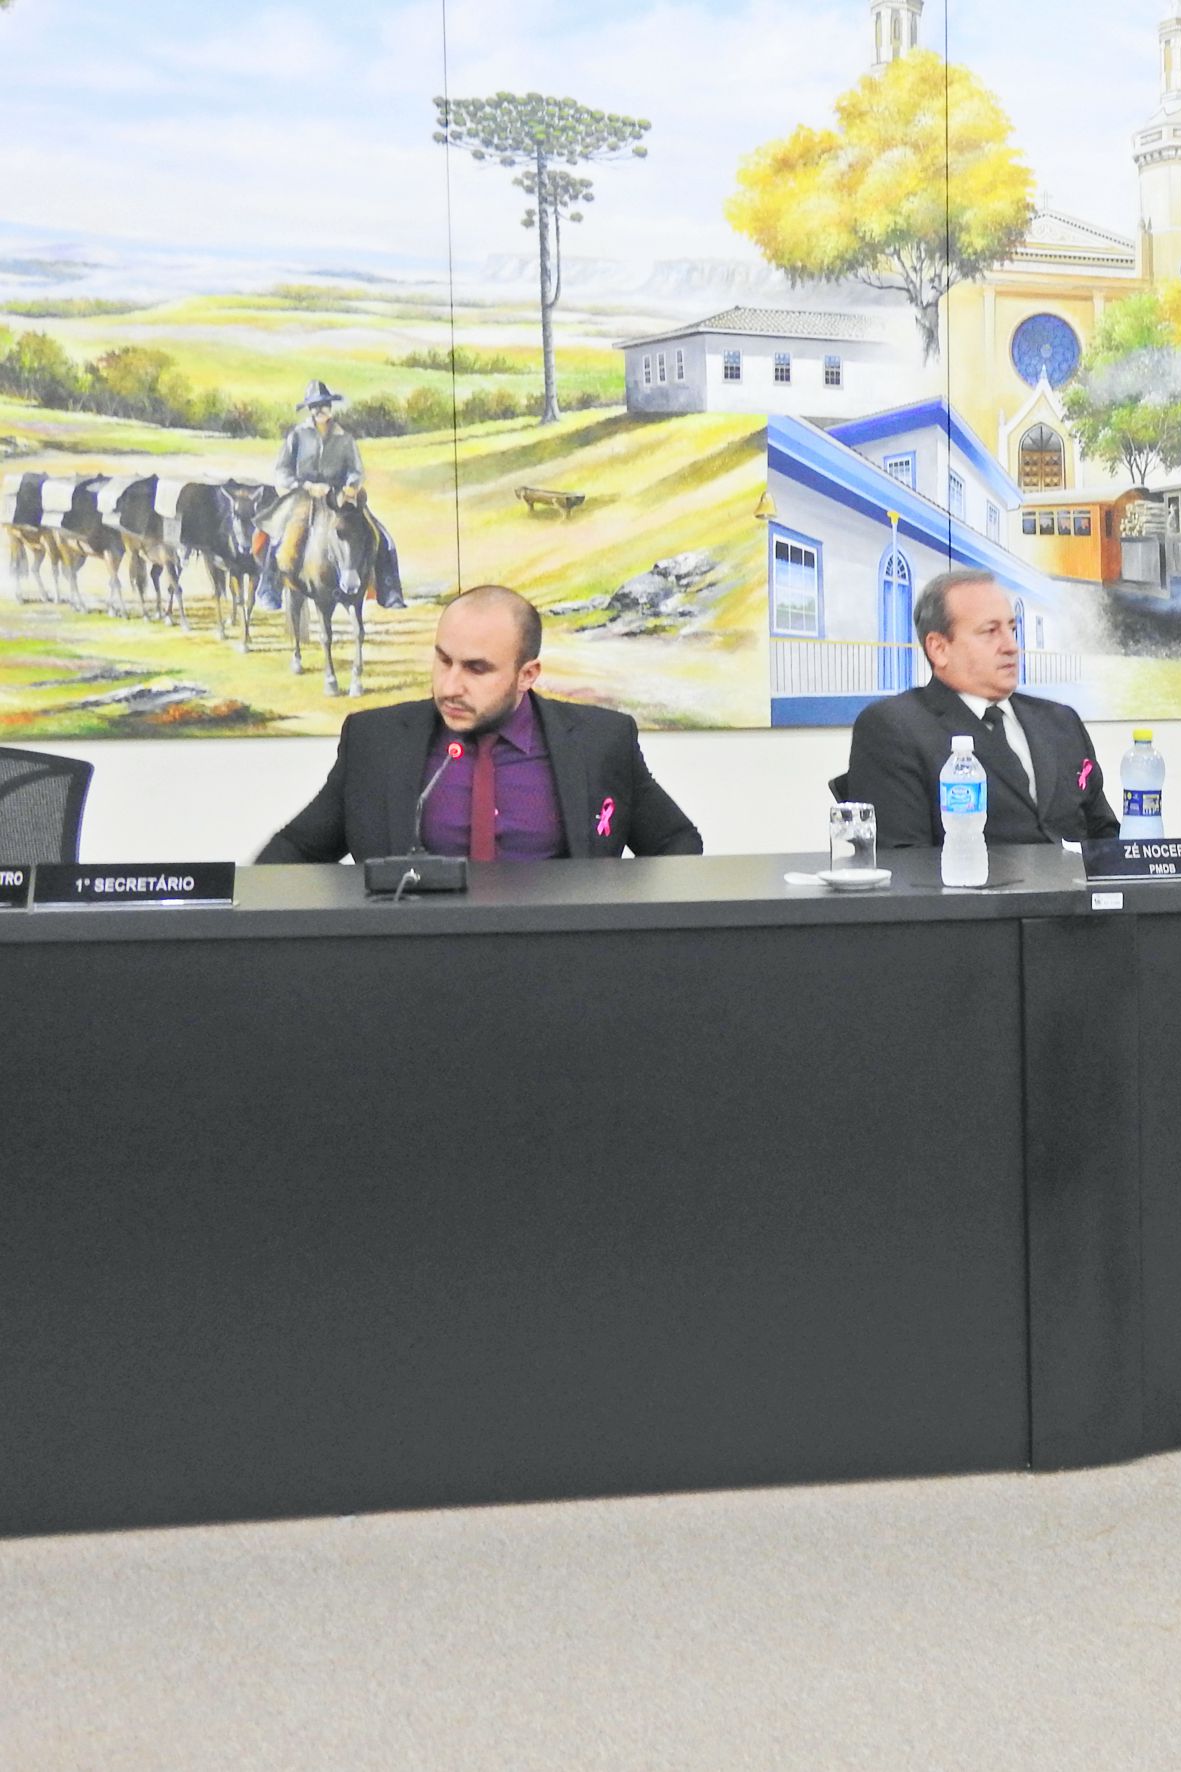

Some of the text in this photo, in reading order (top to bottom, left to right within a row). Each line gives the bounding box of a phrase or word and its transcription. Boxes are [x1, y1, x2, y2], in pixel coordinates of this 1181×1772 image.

[1124, 844, 1141, 858] ZÉ
[1149, 863, 1177, 875] PMDB
[94, 874, 195, 892] SECRETÁRIO
